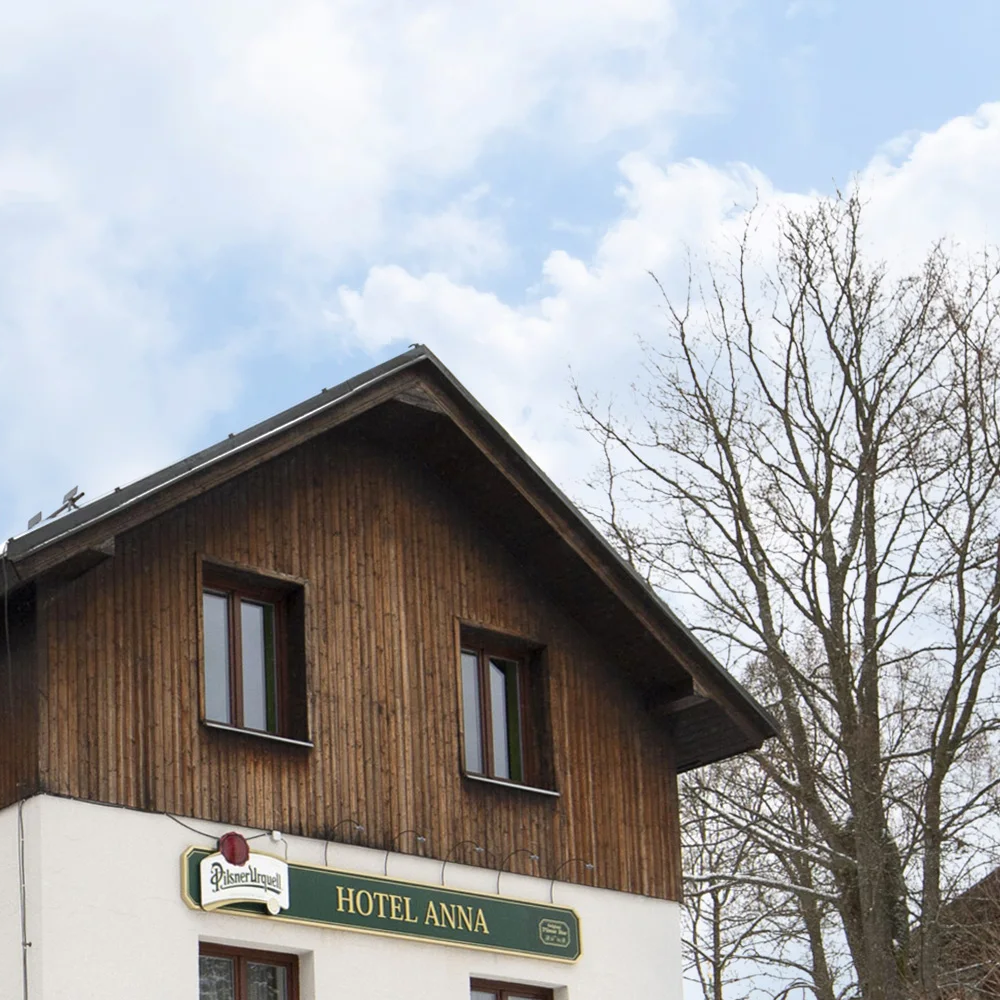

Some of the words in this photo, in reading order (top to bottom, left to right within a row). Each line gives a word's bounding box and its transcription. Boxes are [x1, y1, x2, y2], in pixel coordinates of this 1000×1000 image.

[210, 862, 250, 893] Pilsner
[248, 864, 282, 893] Urquell
[335, 885, 418, 923] HOTEL
[424, 900, 490, 934] ANNA
